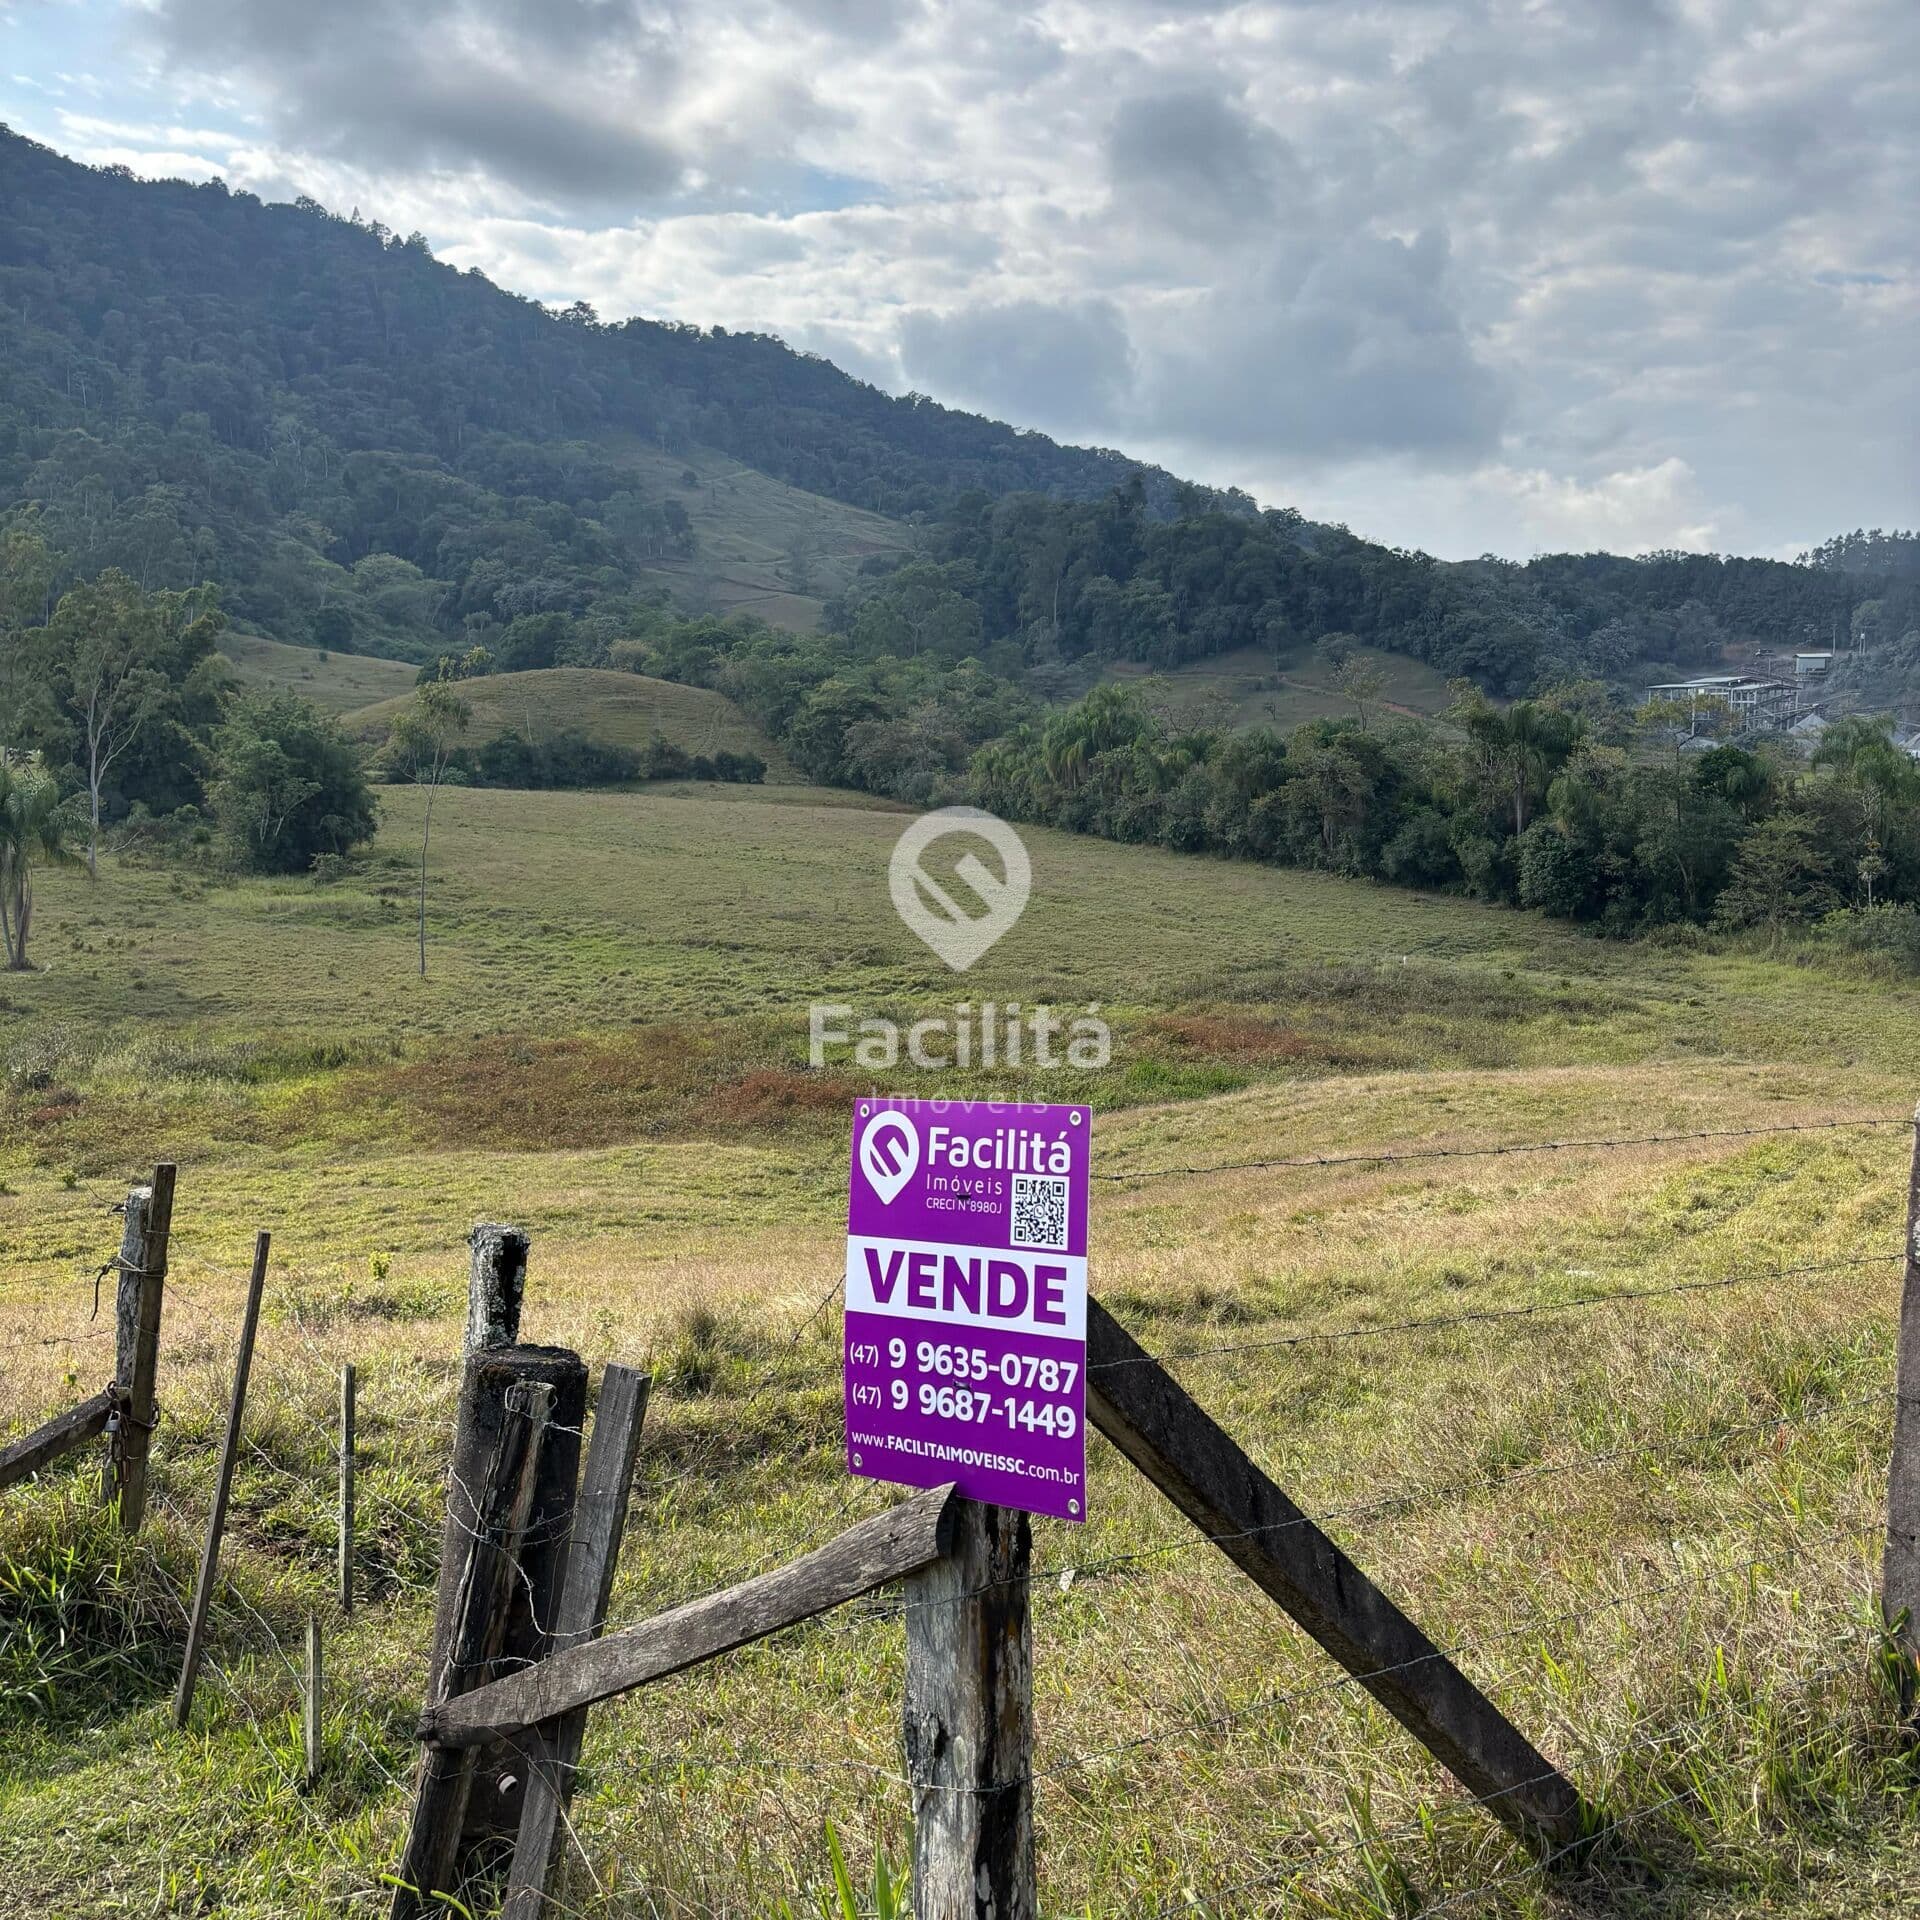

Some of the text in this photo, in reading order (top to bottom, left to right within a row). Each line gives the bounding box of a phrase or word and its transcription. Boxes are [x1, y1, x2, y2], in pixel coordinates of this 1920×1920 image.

[927, 1126, 1071, 1174] Facilitá
[926, 1173, 1003, 1195] Imóveis
[926, 1197, 955, 1210] CRECI
[864, 1248, 1067, 1326] VENDE
[850, 1338, 1079, 1394] (47) 9 9635-0787
[852, 1379, 1077, 1439] (47) 9 9687-1449
[851, 1431, 1080, 1485] www.FACILITAIMOVEISSC.com.br
